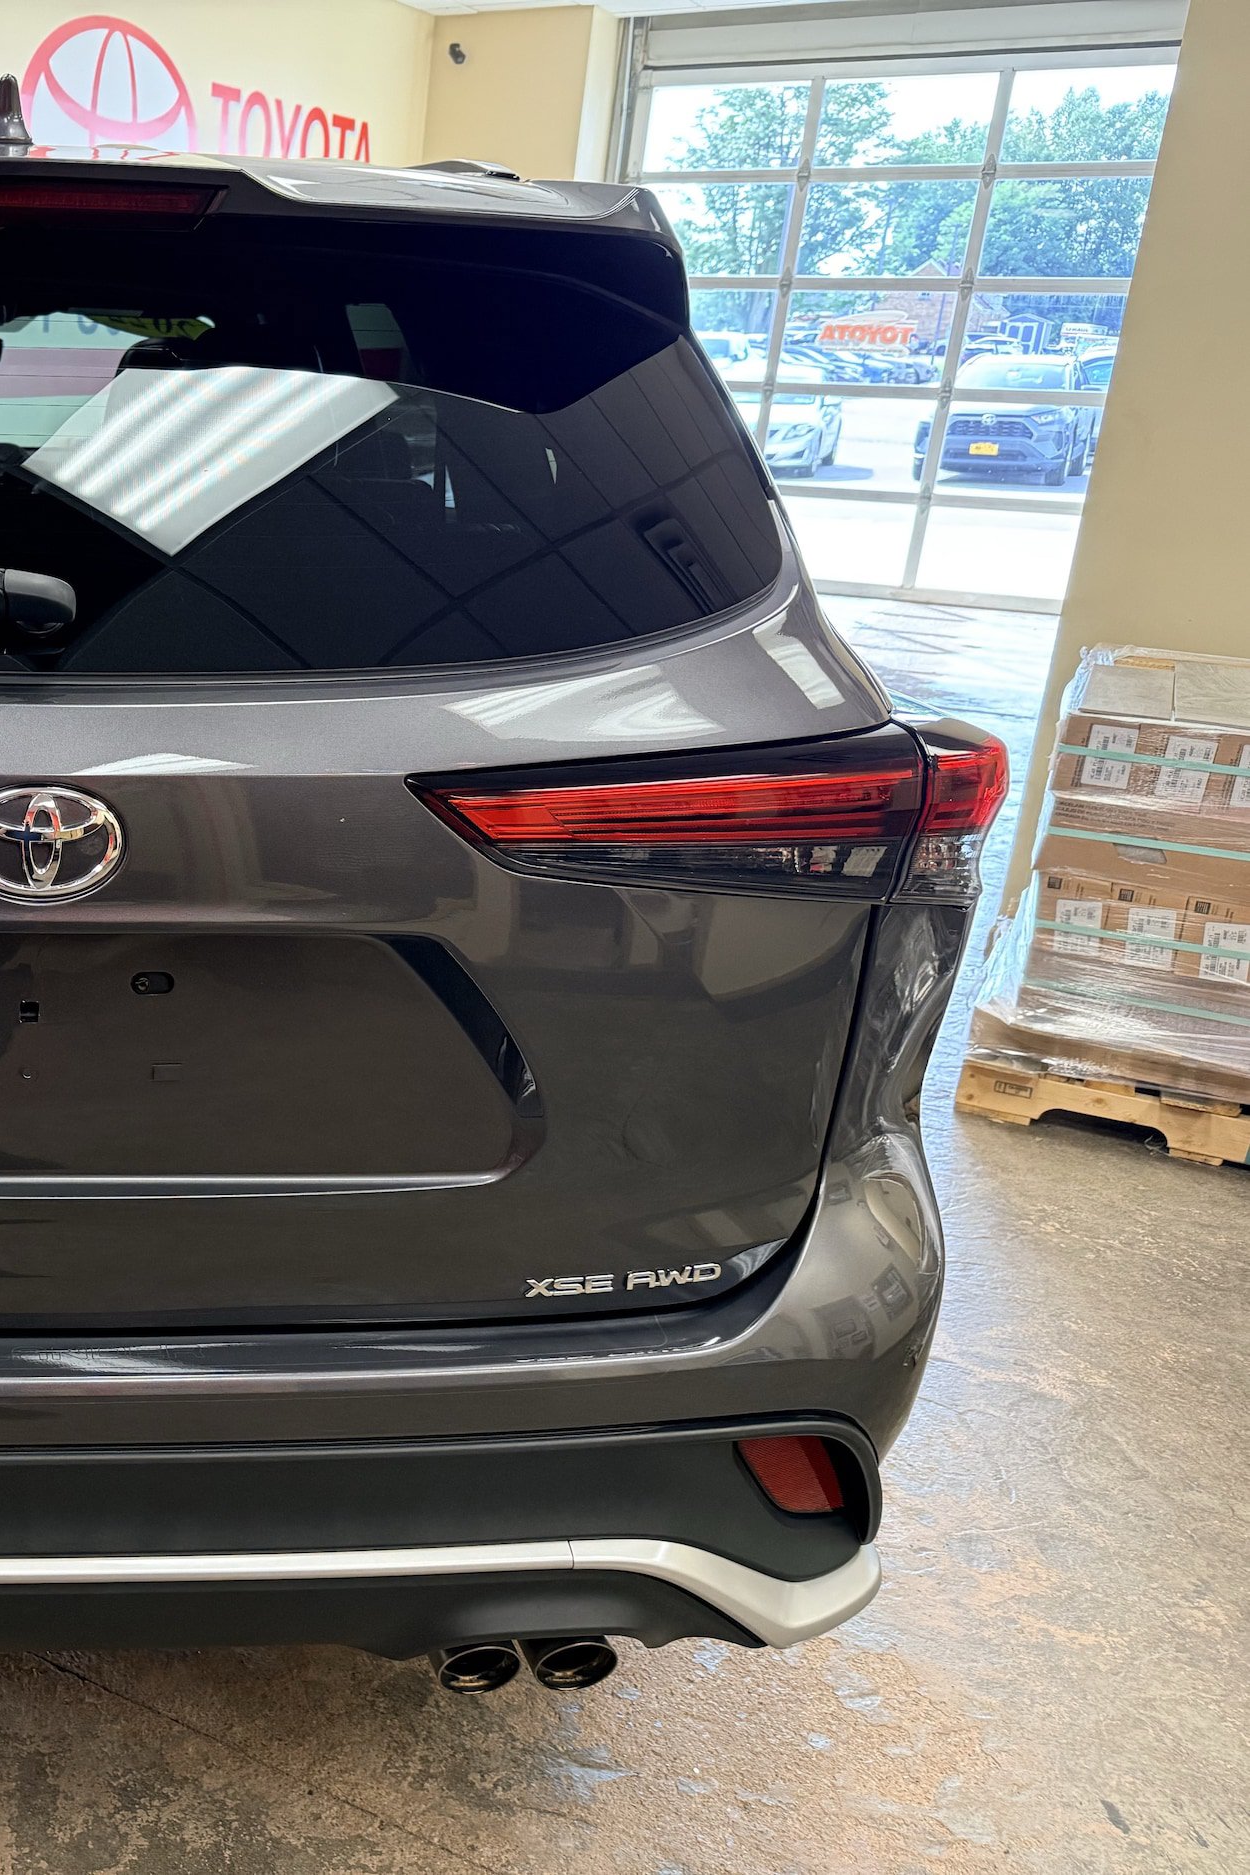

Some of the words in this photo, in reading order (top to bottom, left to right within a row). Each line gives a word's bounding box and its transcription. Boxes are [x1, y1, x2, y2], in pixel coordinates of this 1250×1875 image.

[211, 81, 370, 163] TOYOTA
[524, 1274, 614, 1297] XSE
[626, 1262, 722, 1290] AWD
